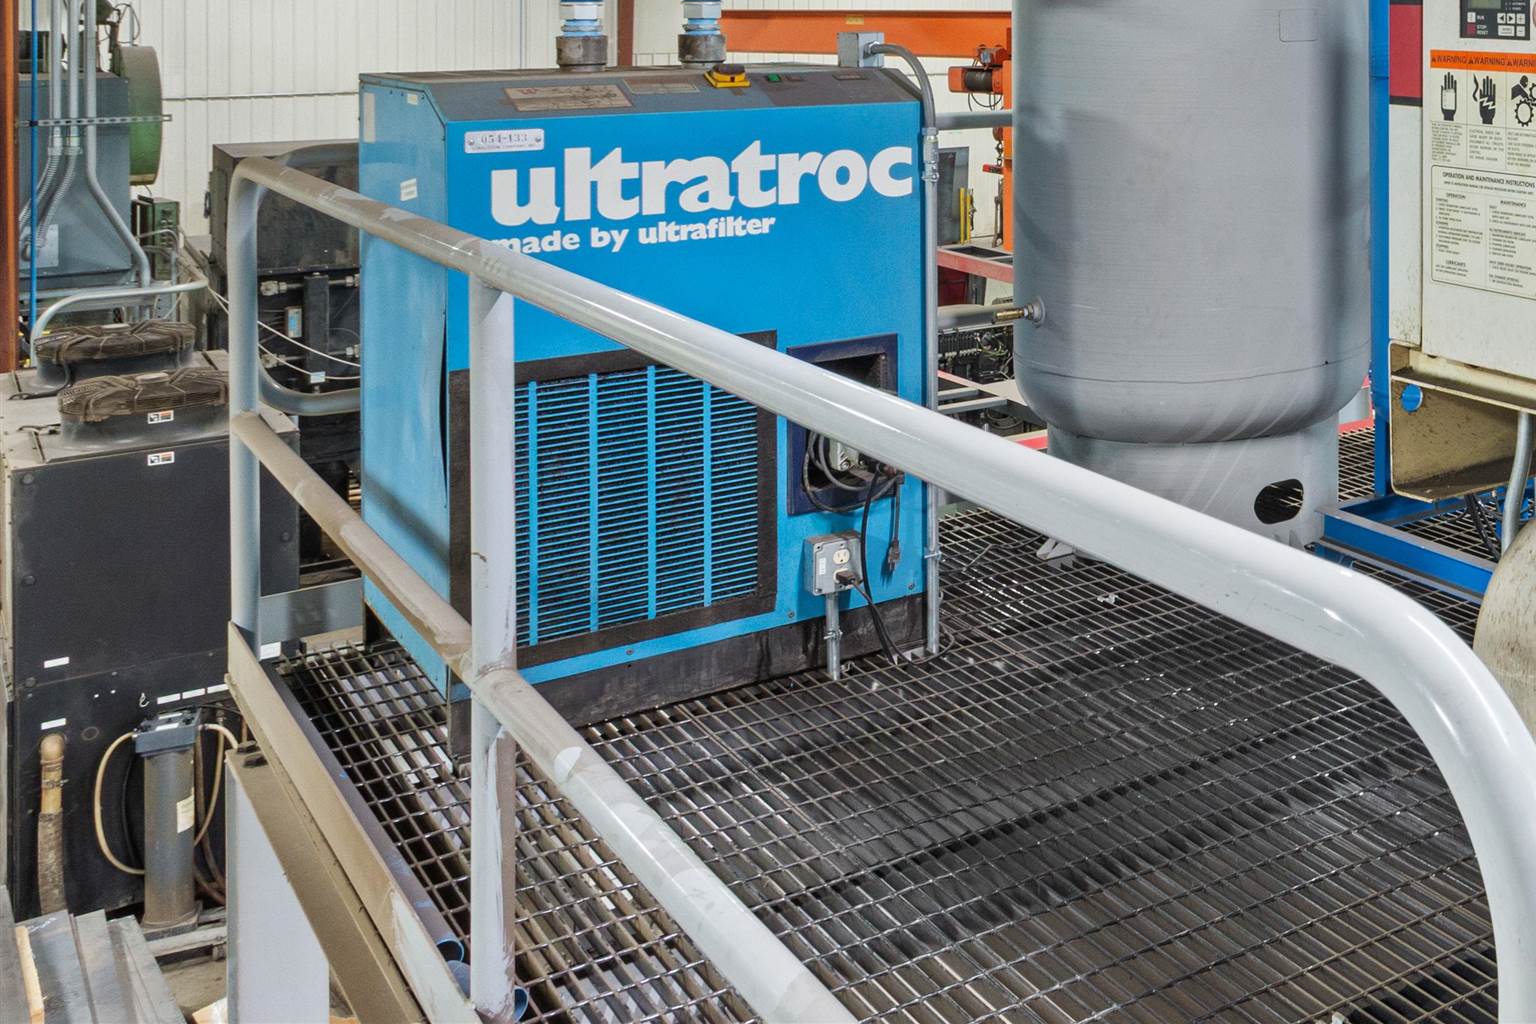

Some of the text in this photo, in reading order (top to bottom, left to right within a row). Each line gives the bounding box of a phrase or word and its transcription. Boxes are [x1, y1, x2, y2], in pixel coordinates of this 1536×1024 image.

[1436, 55, 1467, 64] WARNING
[1473, 57, 1505, 66] WARNING
[491, 140, 913, 226] ultratroc
[491, 217, 776, 256] made by ultrafilter
